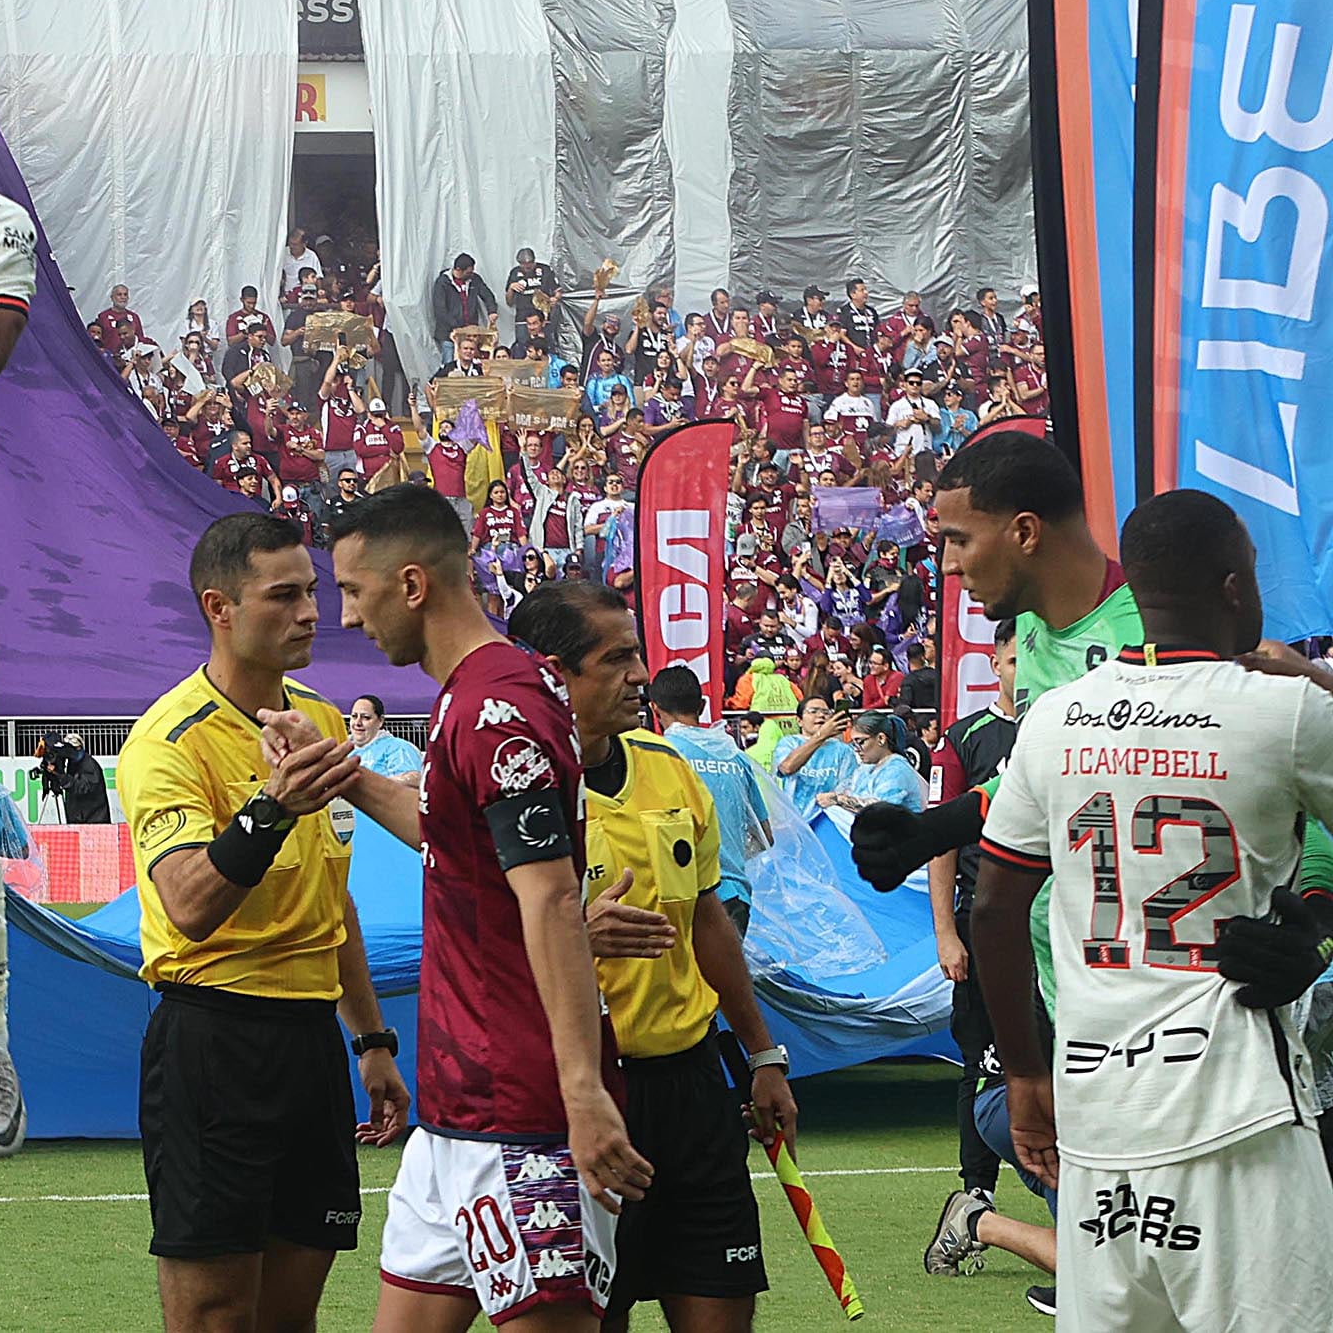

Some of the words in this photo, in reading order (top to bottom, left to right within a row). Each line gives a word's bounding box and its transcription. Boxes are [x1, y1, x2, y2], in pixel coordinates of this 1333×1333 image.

[1063, 701, 1106, 727] Dos
[1133, 701, 1221, 729] Pinos
[1060, 747, 1228, 780] J.CAMPBELL
[1067, 792, 1242, 973] 12
[1065, 1026, 1209, 1074] BYD
[455, 1194, 516, 1273] 20
